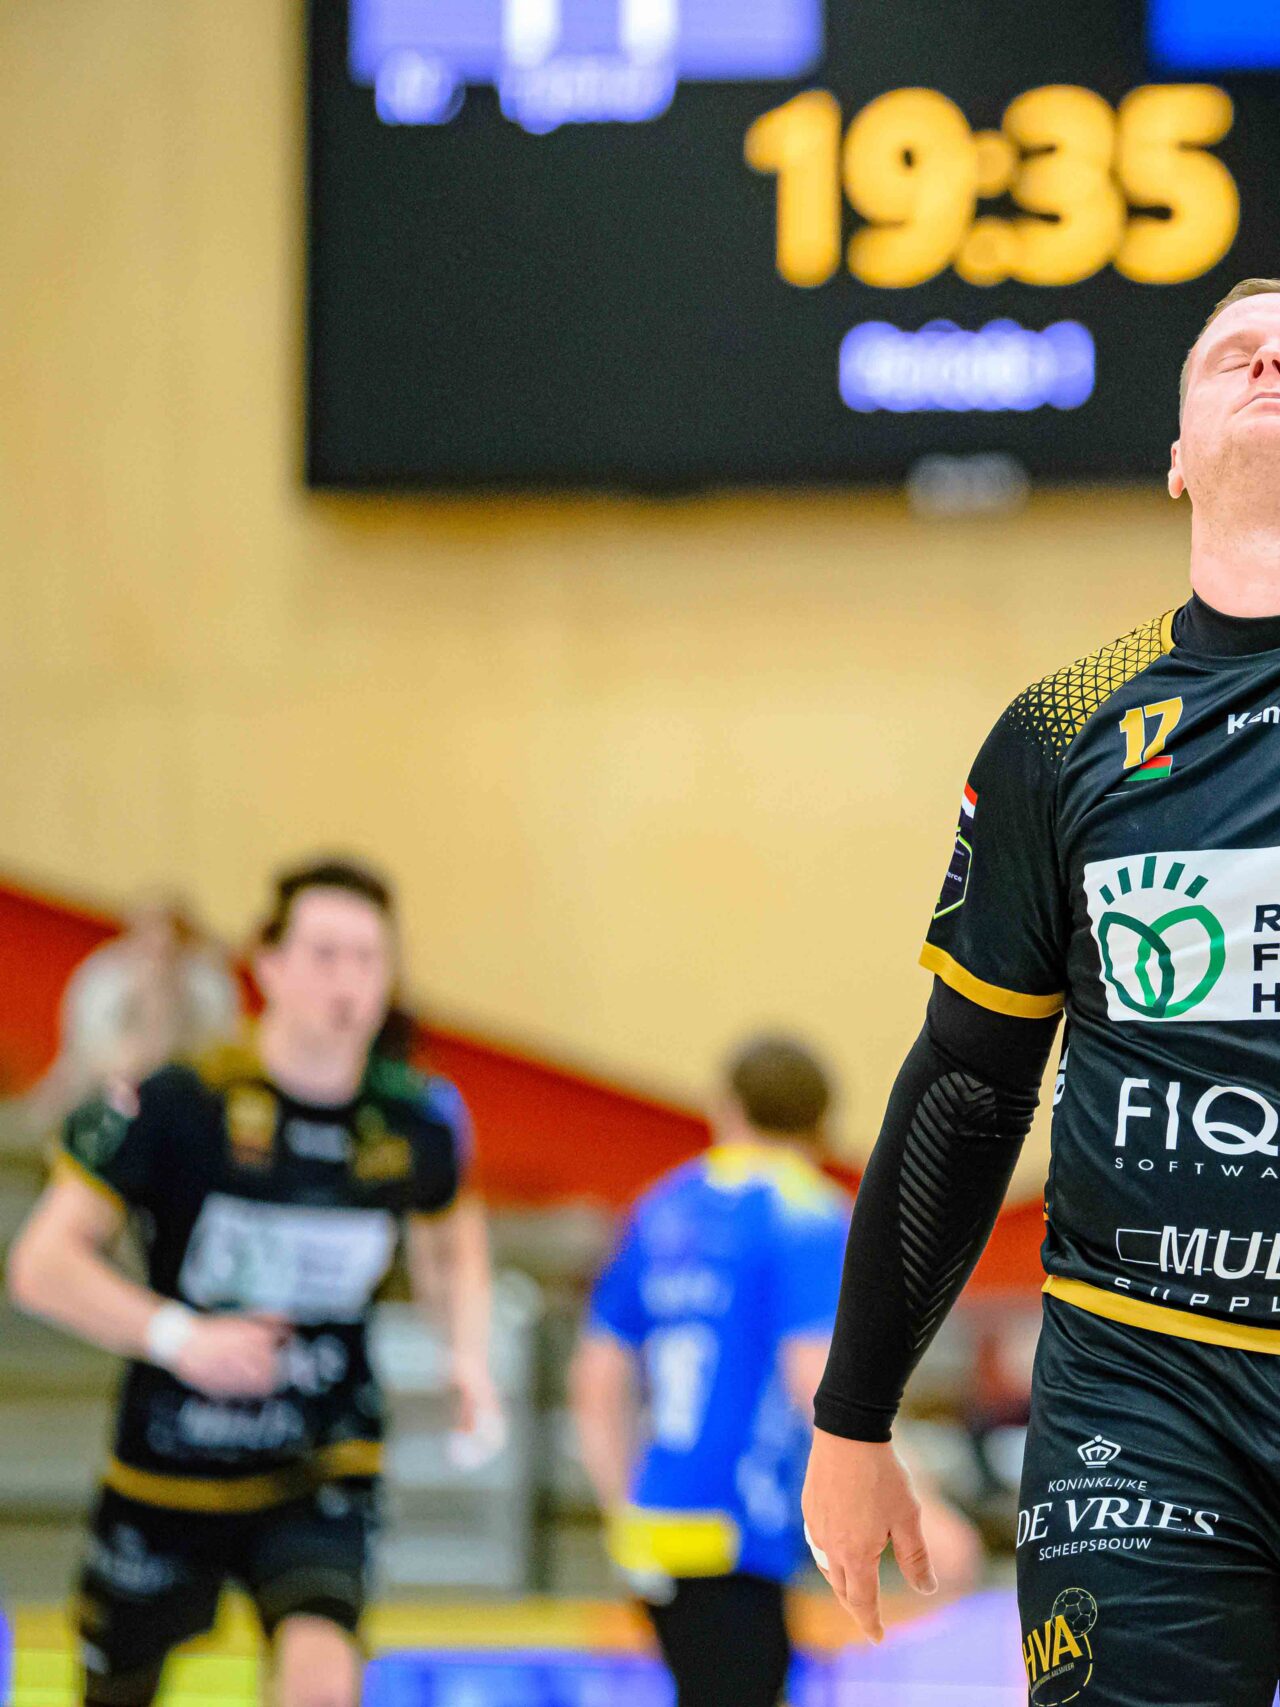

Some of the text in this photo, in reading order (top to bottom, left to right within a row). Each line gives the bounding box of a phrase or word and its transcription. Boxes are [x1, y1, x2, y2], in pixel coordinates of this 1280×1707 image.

[743, 83, 1241, 289] 19:35
[1119, 696, 1183, 769] 17
[1047, 1476, 1148, 1493] KONINKLIJKE
[1016, 1497, 1220, 1549] DE VRIES
[1038, 1537, 1152, 1561] SCHEEPSBOUW
[1022, 1615, 1084, 1690] HVA
